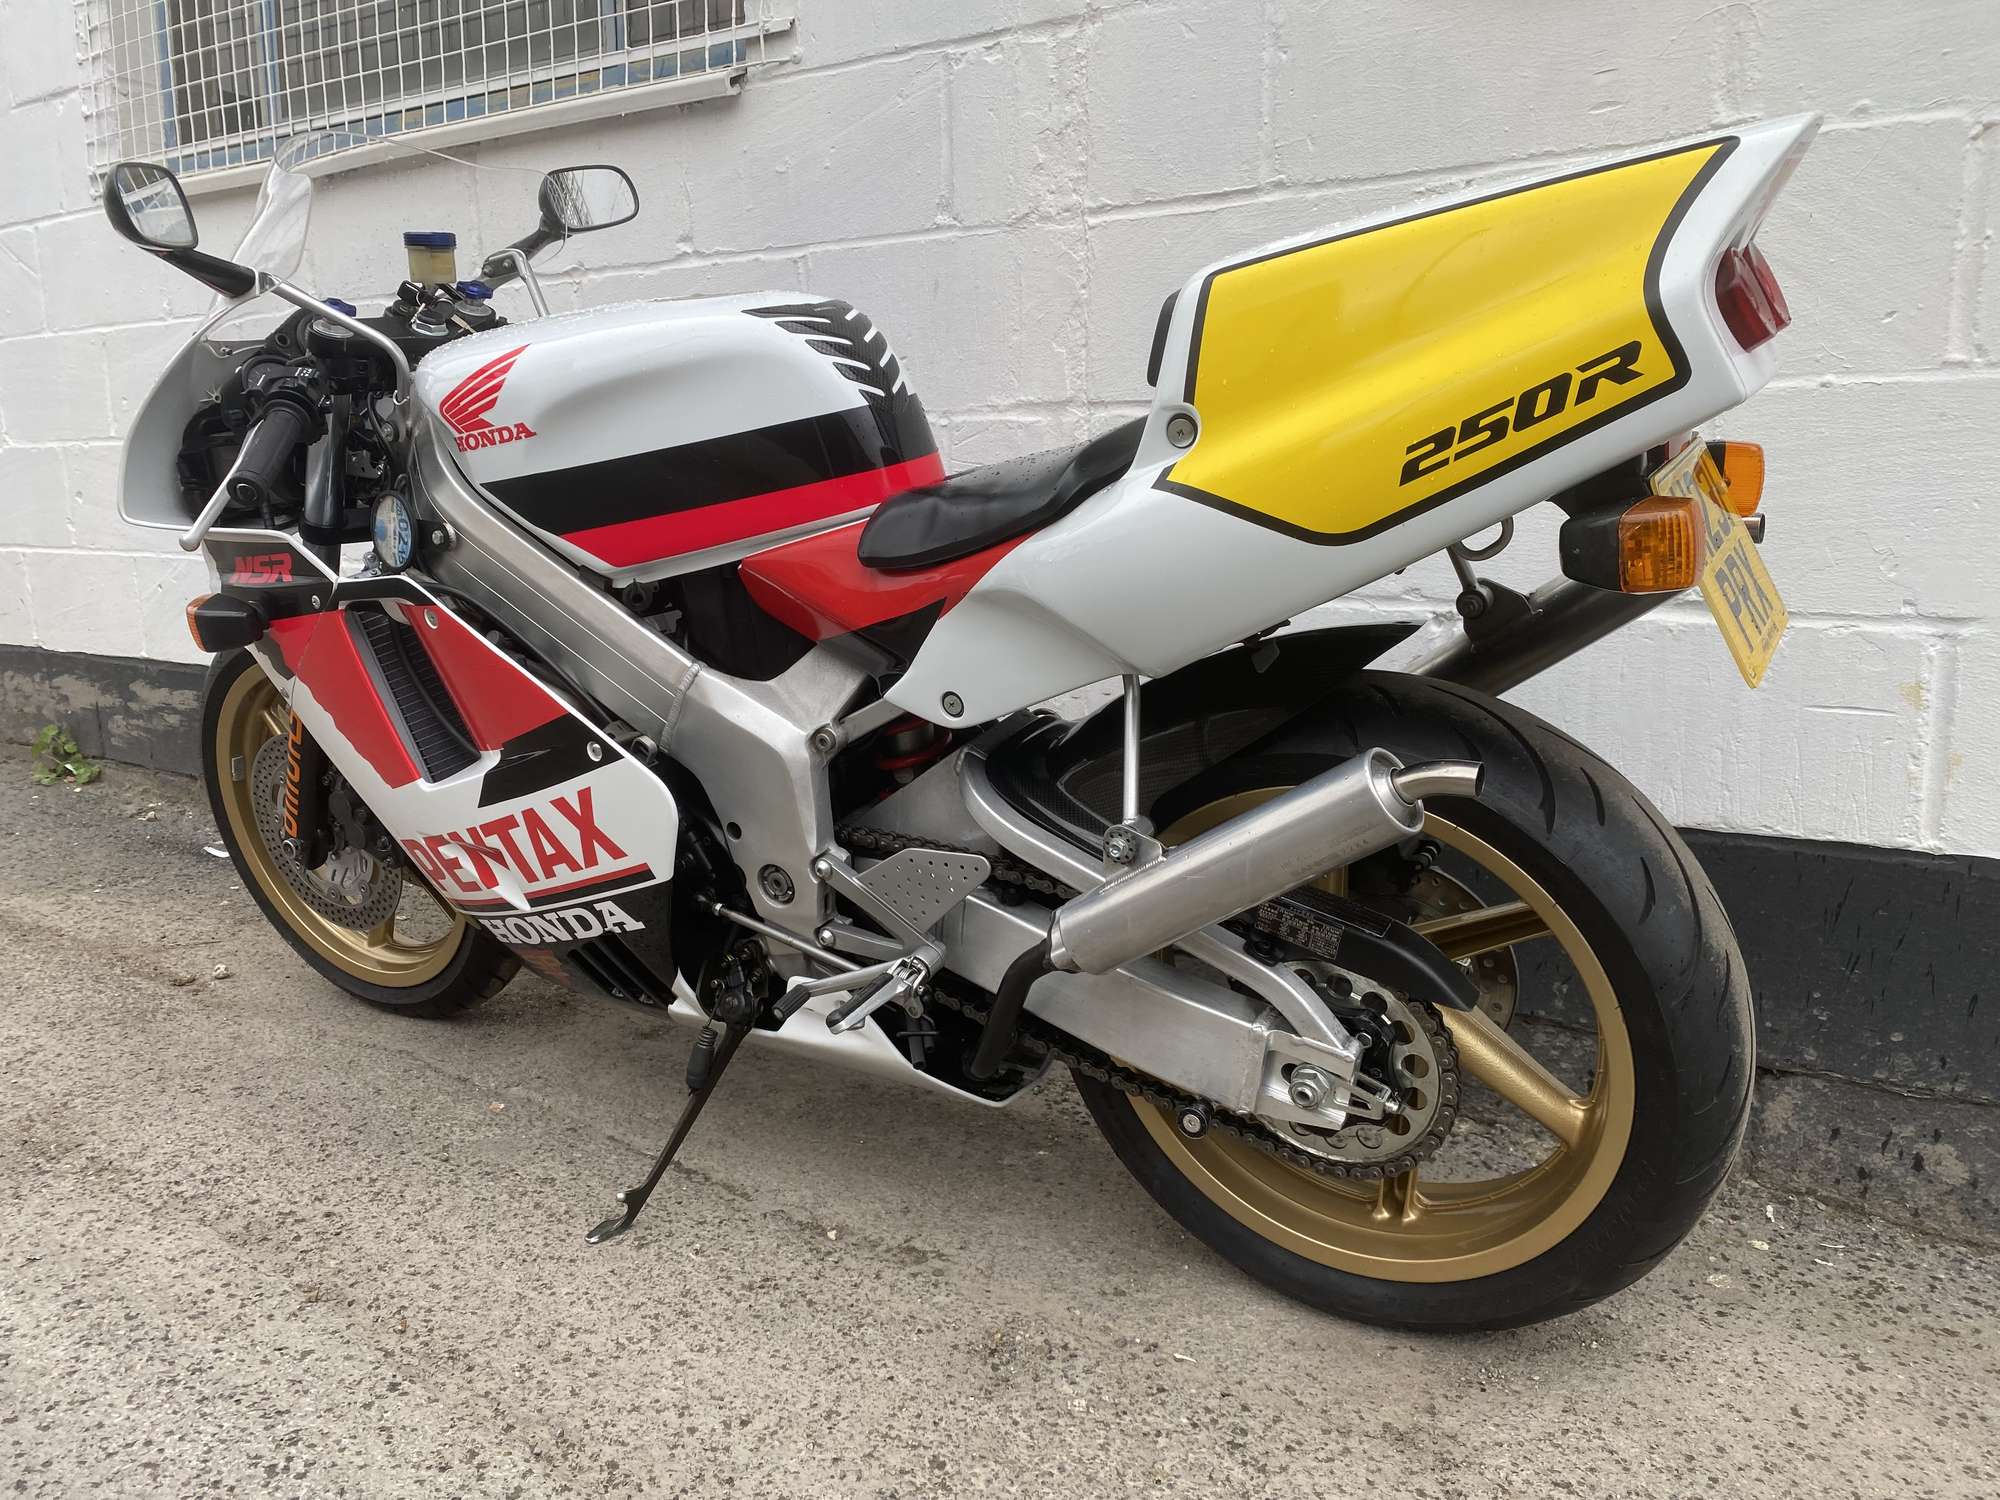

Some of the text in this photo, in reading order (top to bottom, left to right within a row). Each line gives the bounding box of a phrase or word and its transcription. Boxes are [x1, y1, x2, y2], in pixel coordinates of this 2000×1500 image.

[454, 421, 537, 453] HONDA
[1398, 340, 1646, 487] 250R
[229, 552, 293, 584] NSR
[1714, 537, 1774, 654] PRX
[400, 786, 629, 893] PENTAX
[478, 900, 647, 945] HONDA
